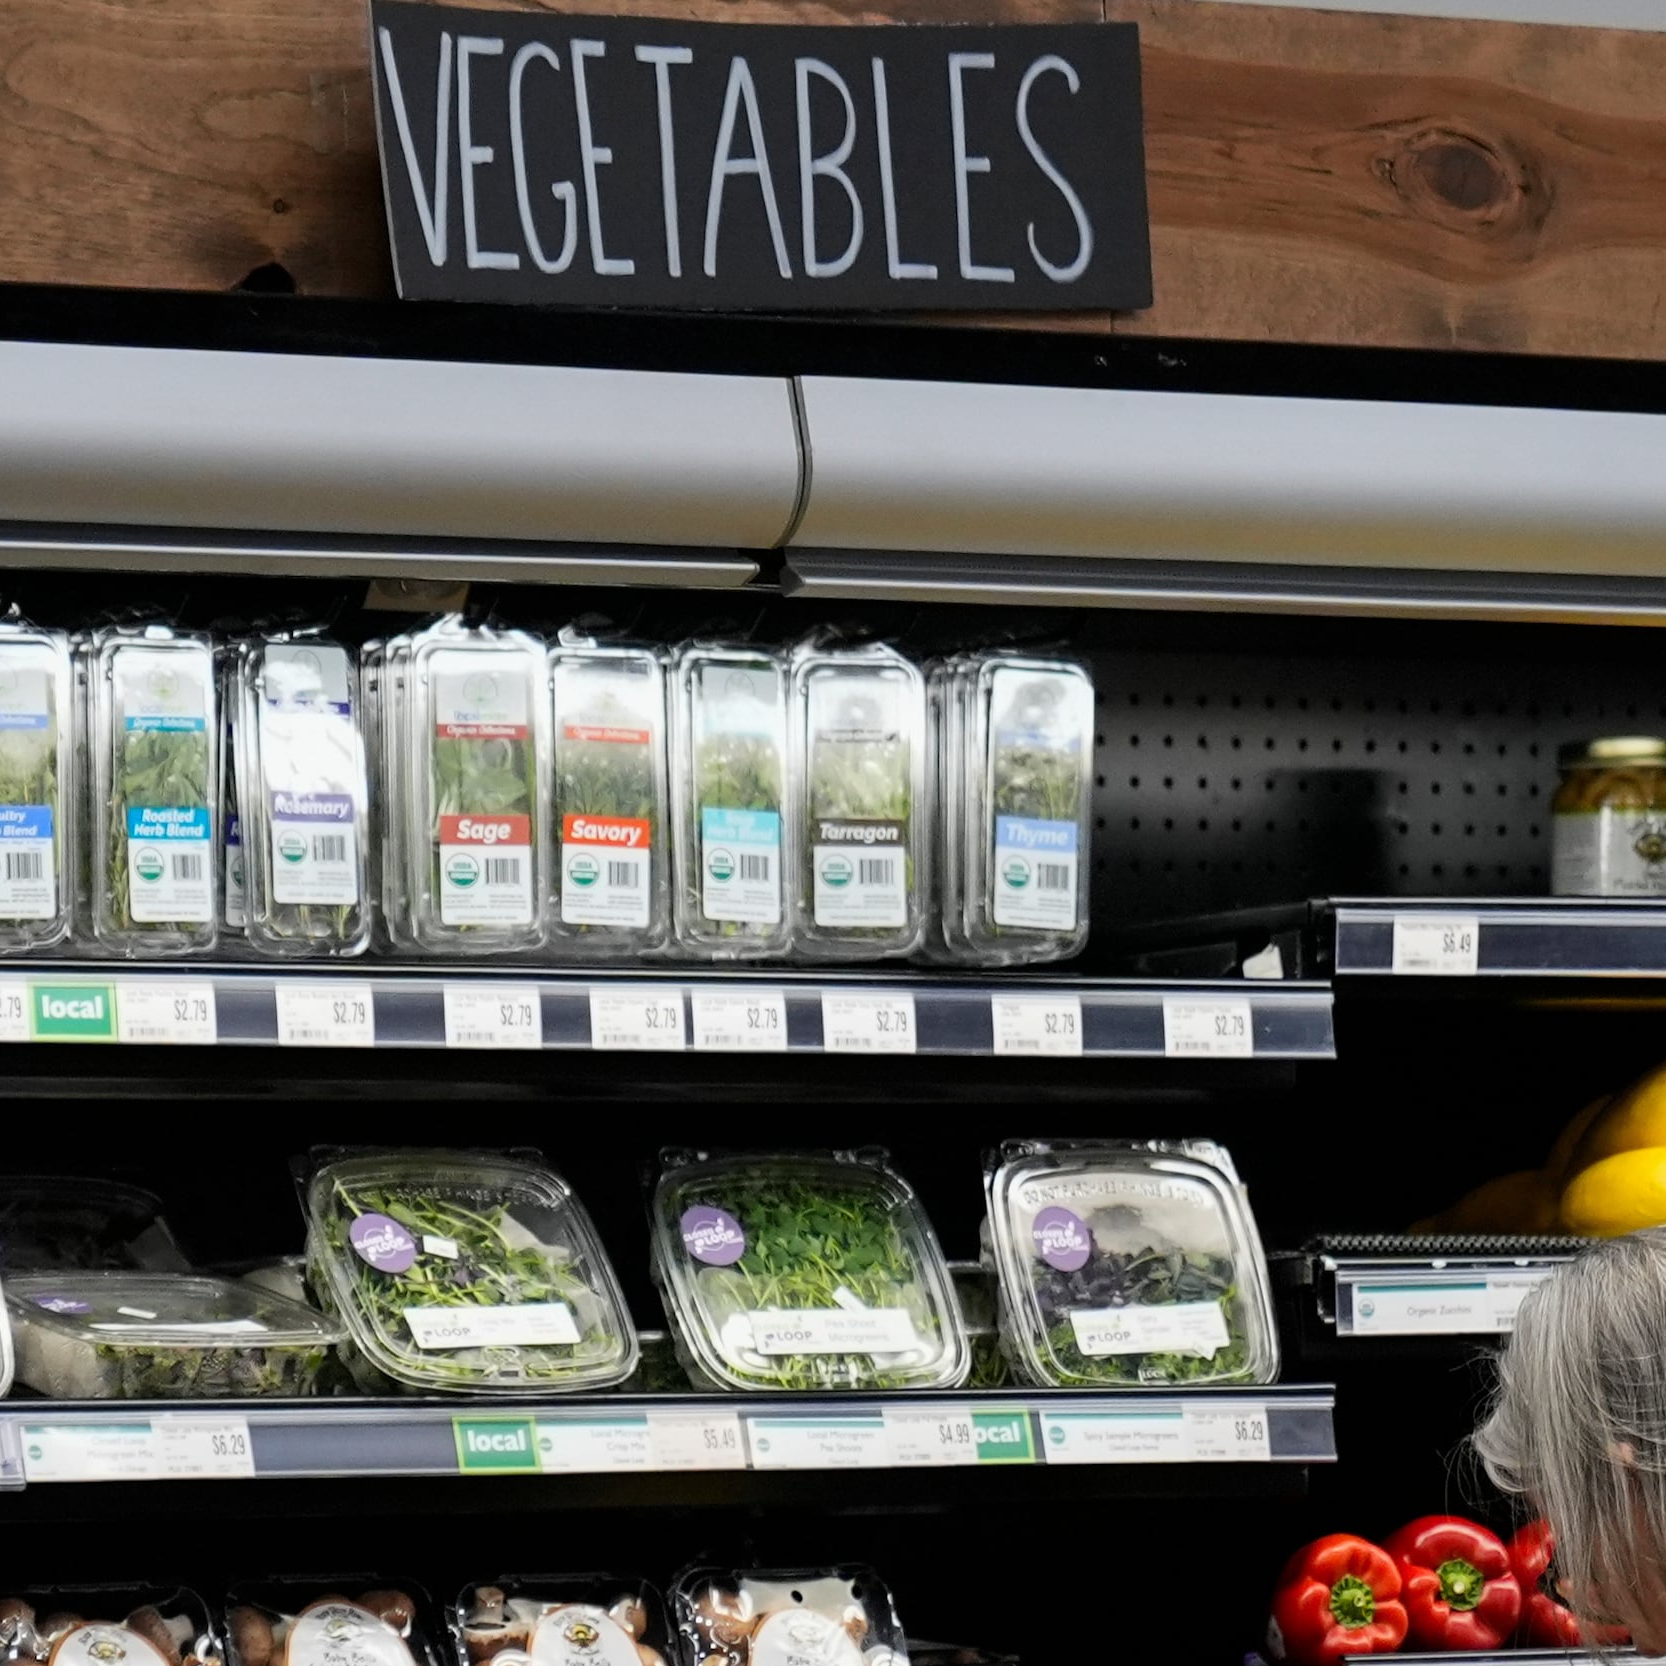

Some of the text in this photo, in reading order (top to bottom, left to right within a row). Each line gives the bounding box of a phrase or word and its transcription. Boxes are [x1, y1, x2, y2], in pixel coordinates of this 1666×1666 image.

[378, 25, 1095, 283] VEGETABLES
[141, 808, 195, 823] Roasted
[274, 795, 350, 818] Rosemary
[2, 823, 37, 837] Blend
[134, 823, 204, 837] Herb Blend
[457, 820, 511, 844] Sage
[570, 820, 642, 846] Savory
[818, 823, 899, 843] Tarragon
[1006, 823, 1069, 848] Thyme
[1442, 931, 1473, 956] $6.49
[41, 994, 104, 1020] local
[173, 997, 208, 1022] $2.79
[333, 1001, 366, 1025] $2.79
[500, 1003, 533, 1028] $2.79
[645, 1005, 677, 1030] $2.79
[746, 1006, 779, 1030] $2.79
[875, 1009, 908, 1033] $2.79
[1044, 1010, 1076, 1034] $2.79
[1214, 1013, 1246, 1039] $2.79
[377, 1237, 405, 1252] LOOP
[708, 1230, 735, 1245] LOOP
[1050, 1234, 1082, 1249] LOOP
[434, 1326, 471, 1338] LOOP
[776, 1331, 813, 1342] LOOP
[1097, 1331, 1131, 1343] LOOP
[467, 1429, 526, 1453] local
[703, 1428, 736, 1450] $5.49
[939, 1422, 1020, 1445] $4.99 ocal
[1234, 1420, 1265, 1443] $6.29
[212, 1434, 246, 1457] $6.29
[323, 1651, 347, 1664] Baby
